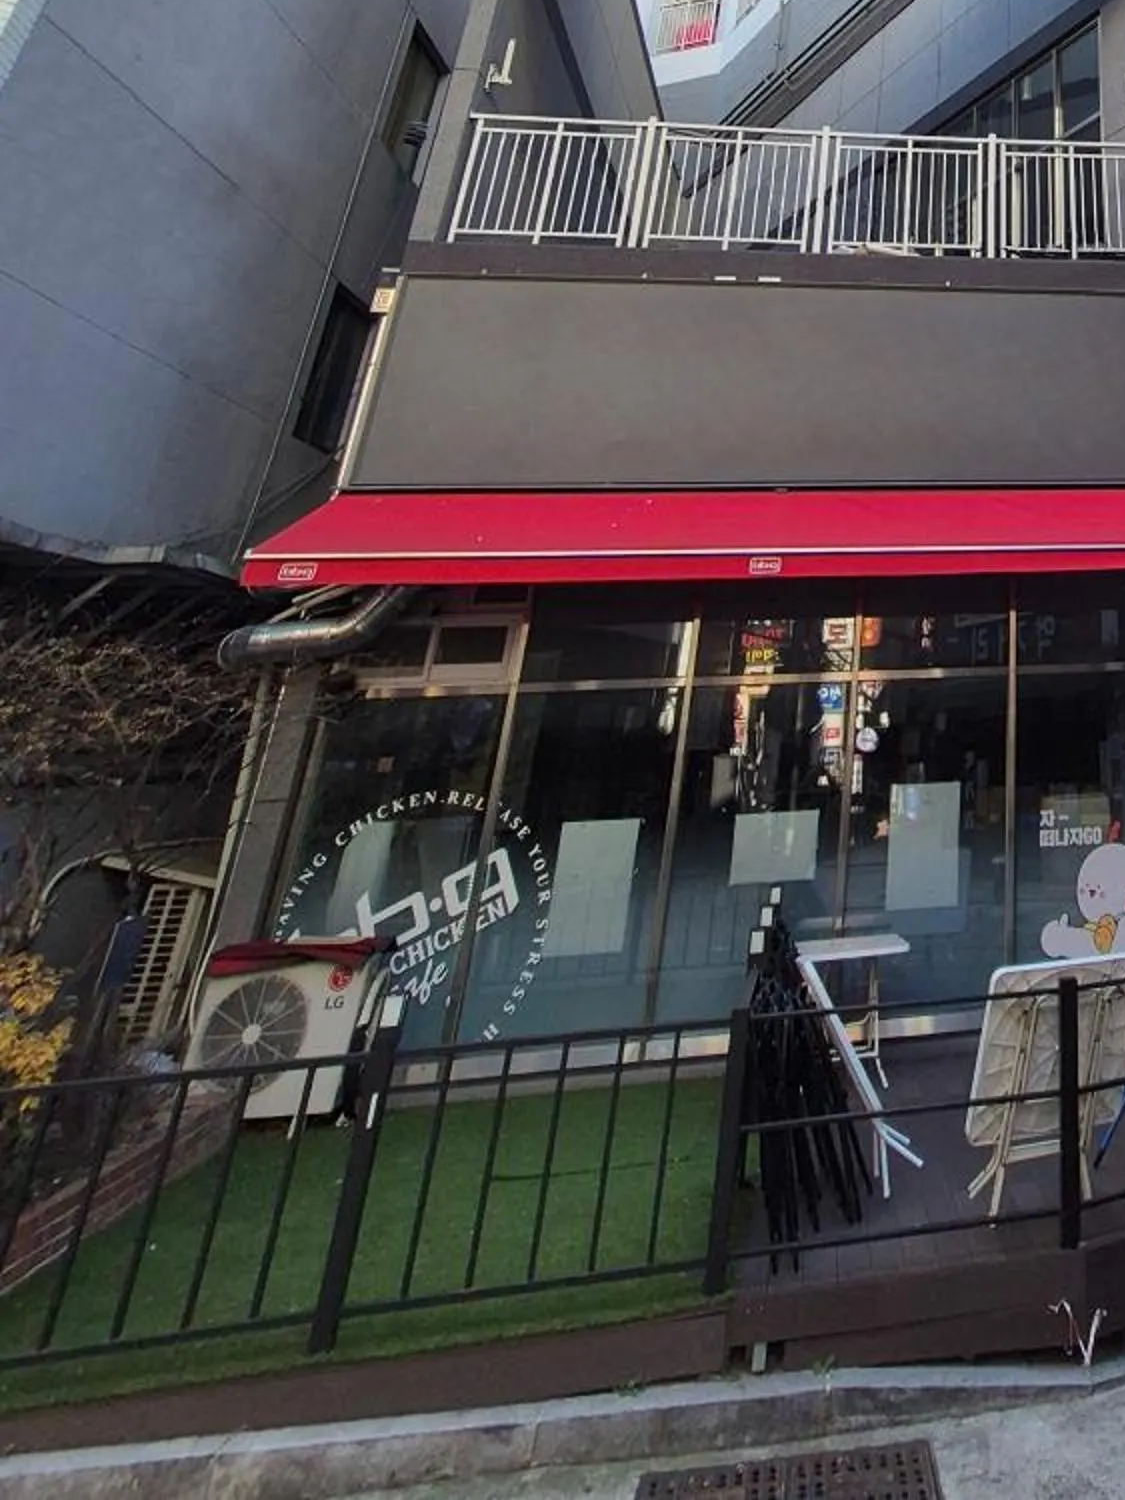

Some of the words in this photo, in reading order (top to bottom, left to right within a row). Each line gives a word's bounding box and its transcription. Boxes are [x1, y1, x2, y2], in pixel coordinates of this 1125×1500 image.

[274, 852, 328, 942] AVING
[528, 843, 552, 905] YOUR
[323, 995, 345, 1011] LG
[503, 918, 549, 1016] STRESS
